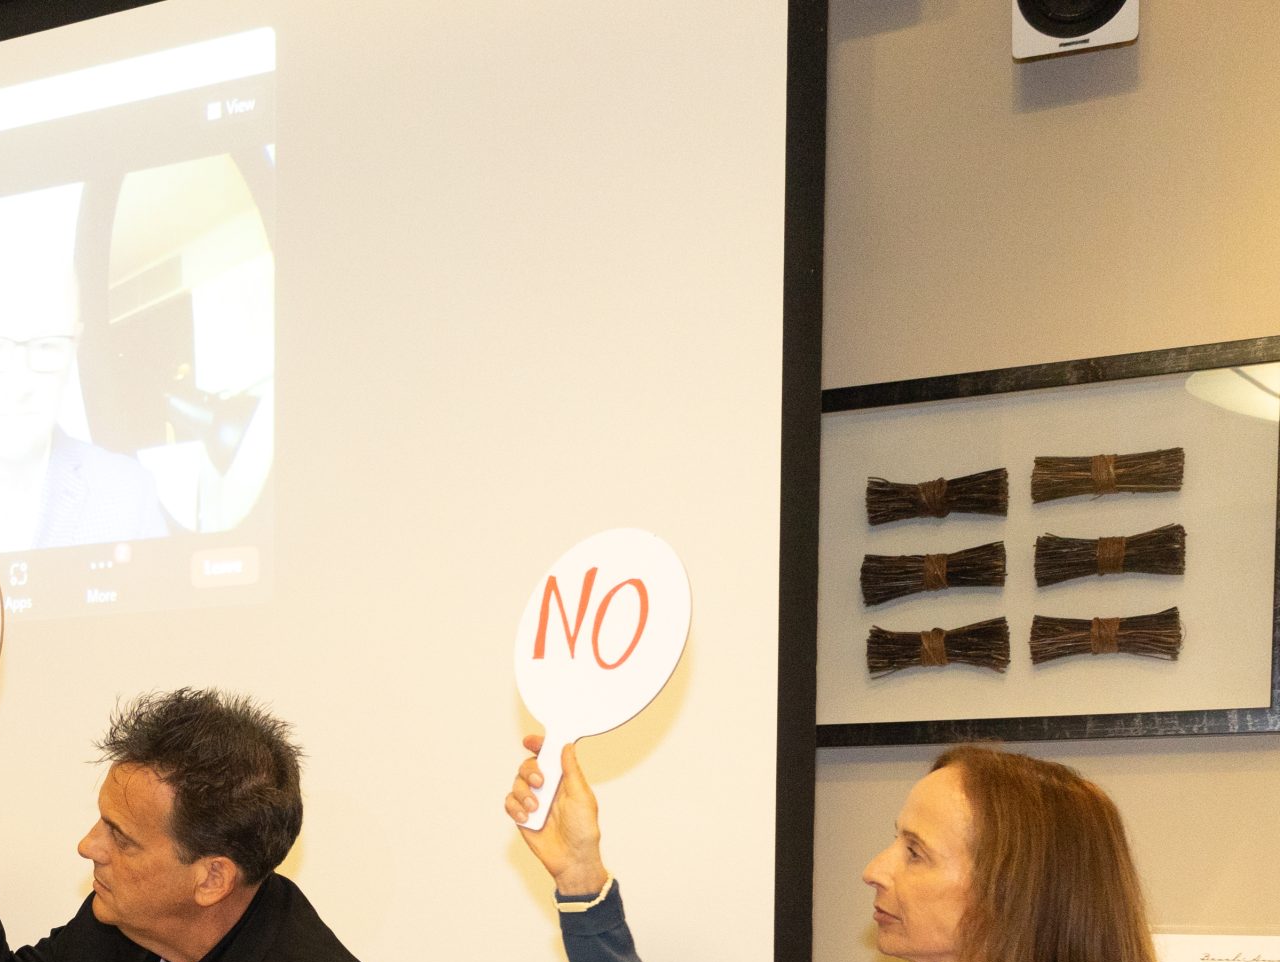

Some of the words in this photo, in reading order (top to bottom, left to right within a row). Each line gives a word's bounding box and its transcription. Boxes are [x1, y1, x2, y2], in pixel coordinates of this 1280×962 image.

[226, 97, 256, 114] View
[5, 596, 32, 613] Apps
[87, 588, 118, 604] More
[532, 566, 649, 670] NO
